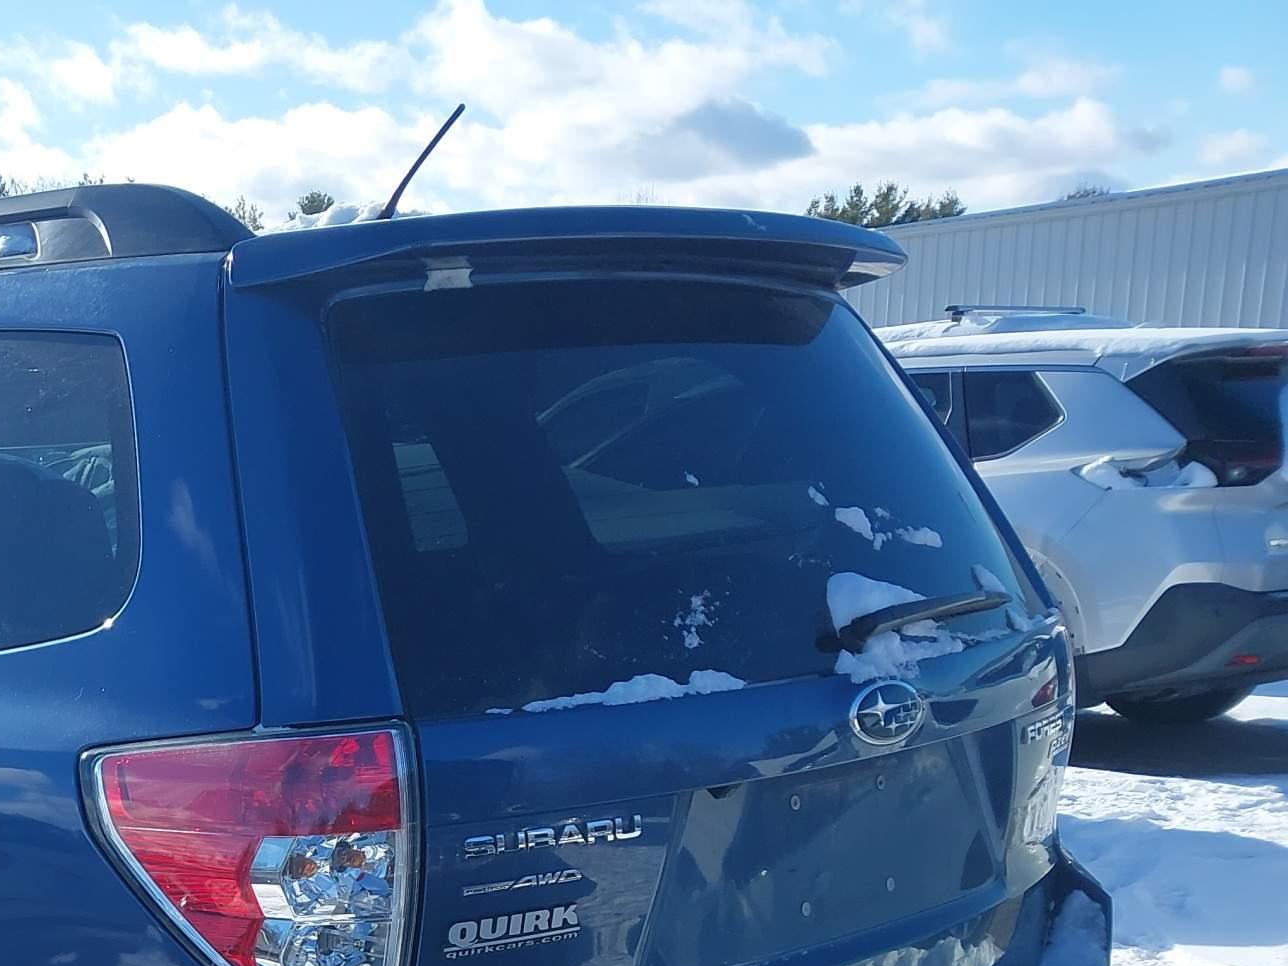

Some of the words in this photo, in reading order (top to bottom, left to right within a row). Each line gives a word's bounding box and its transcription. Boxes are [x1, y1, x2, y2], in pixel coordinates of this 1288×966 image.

[464, 814, 642, 859] SUBARU
[509, 868, 583, 889] AWD
[448, 904, 578, 948] QUIRK
[445, 931, 578, 960] quirkcars.com
